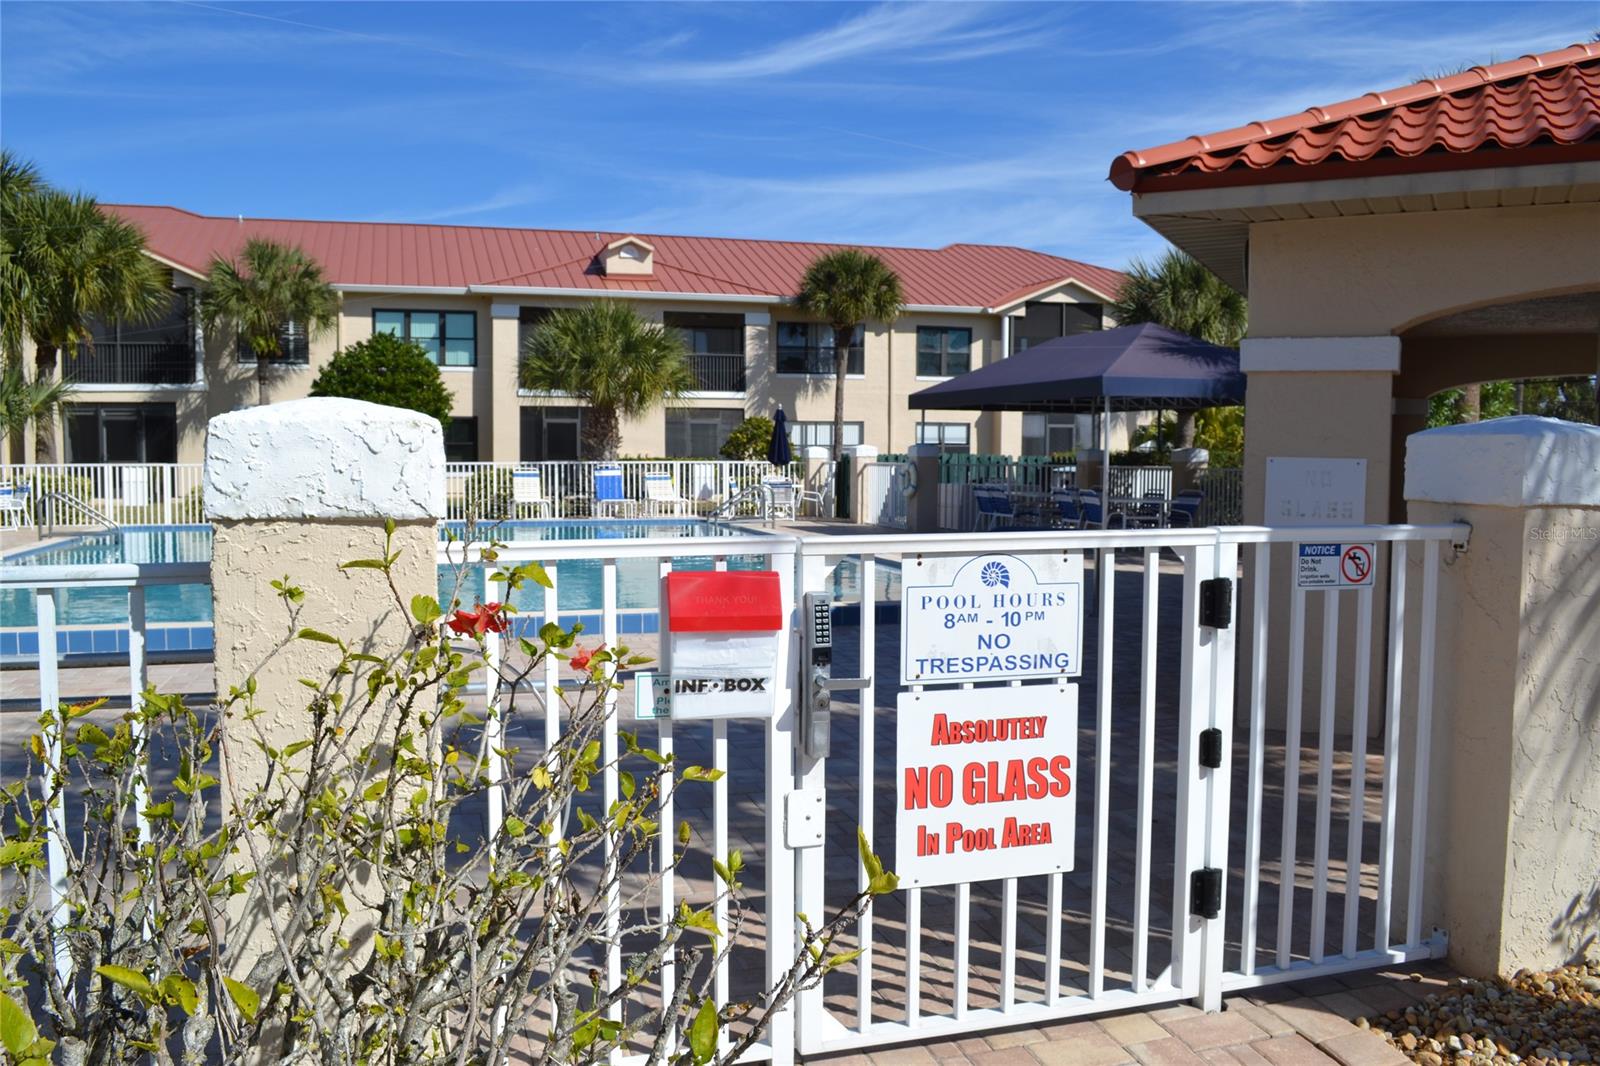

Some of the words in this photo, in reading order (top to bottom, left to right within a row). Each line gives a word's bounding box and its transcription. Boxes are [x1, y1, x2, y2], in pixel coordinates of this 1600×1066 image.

[1304, 545, 1336, 555] NOTICE
[921, 594, 982, 610] POOL
[993, 592, 1067, 608] HOURS
[978, 633, 1011, 650] NO
[916, 652, 1070, 675] TRESPASSING
[931, 713, 1048, 746] ABSOLUTELY
[904, 764, 954, 810] NO
[962, 755, 1071, 805] GLASS
[946, 822, 997, 854] POOL
[1001, 817, 1052, 848] AREA
